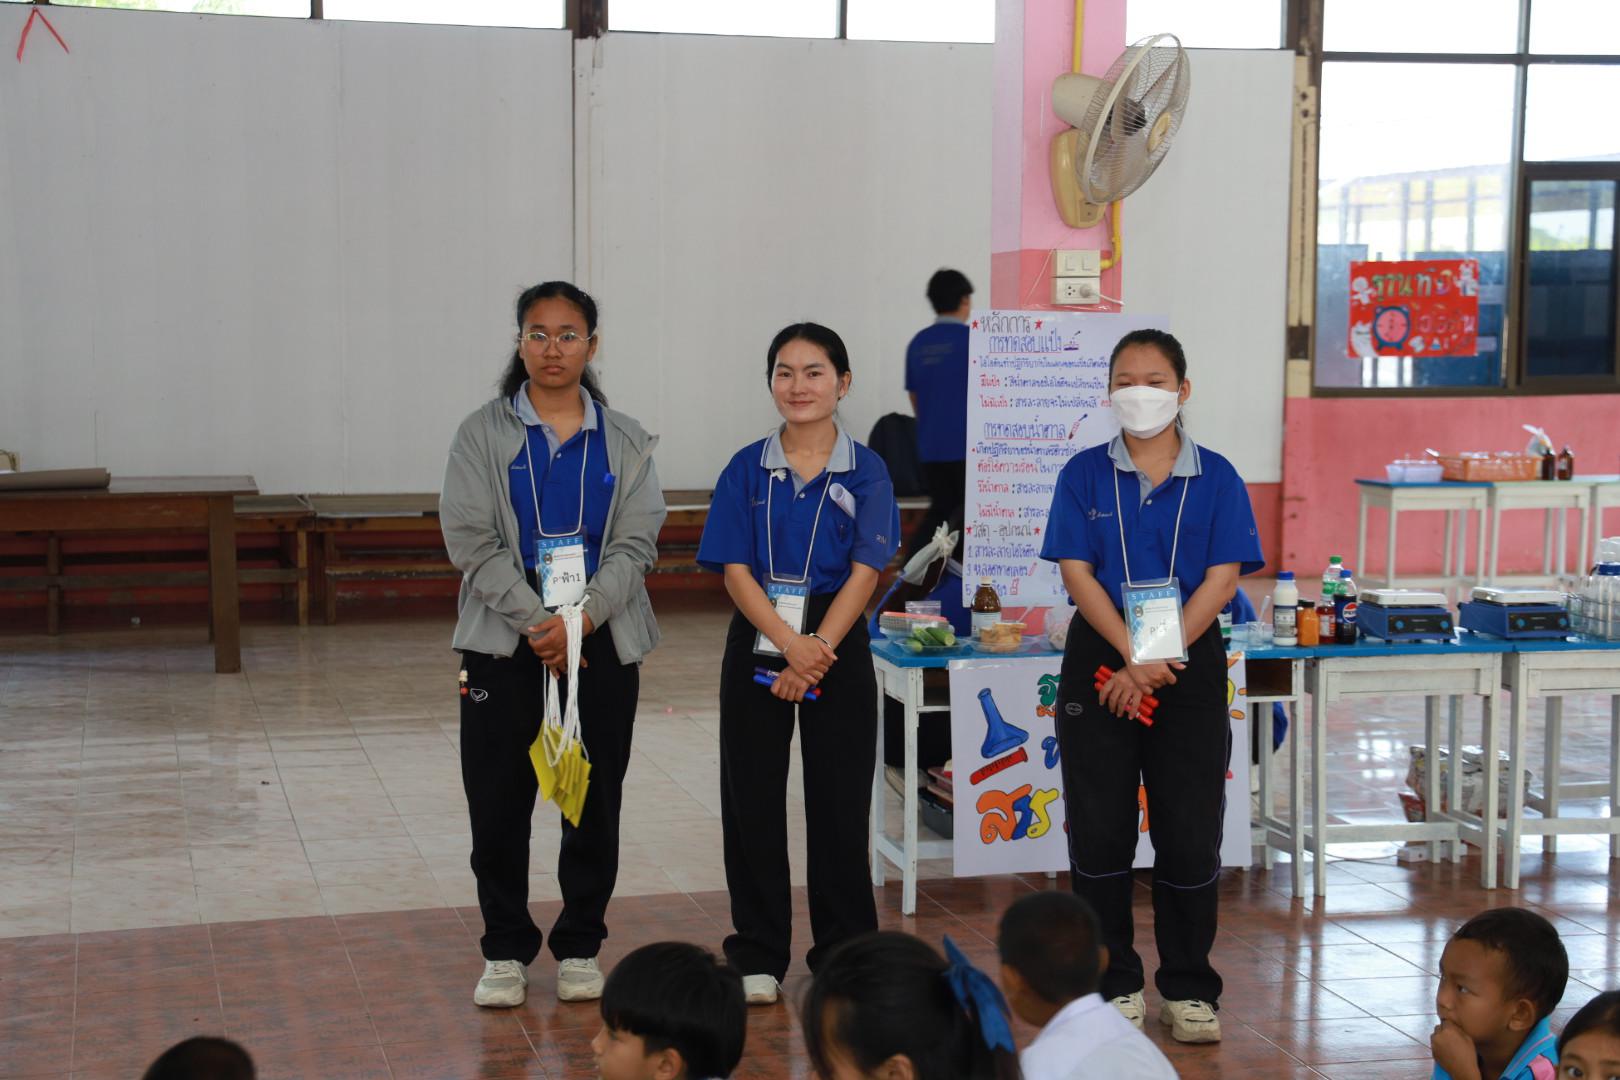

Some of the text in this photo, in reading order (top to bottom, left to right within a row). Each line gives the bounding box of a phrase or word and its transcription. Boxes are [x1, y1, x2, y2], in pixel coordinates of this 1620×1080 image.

[981, 311, 1032, 333] หลักการ
[989, 328, 1062, 352] การทดสอบแป้ง
[541, 538, 580, 549] STAFF
[770, 584, 804, 596] STAFF
[1131, 590, 1172, 600] STAFF
